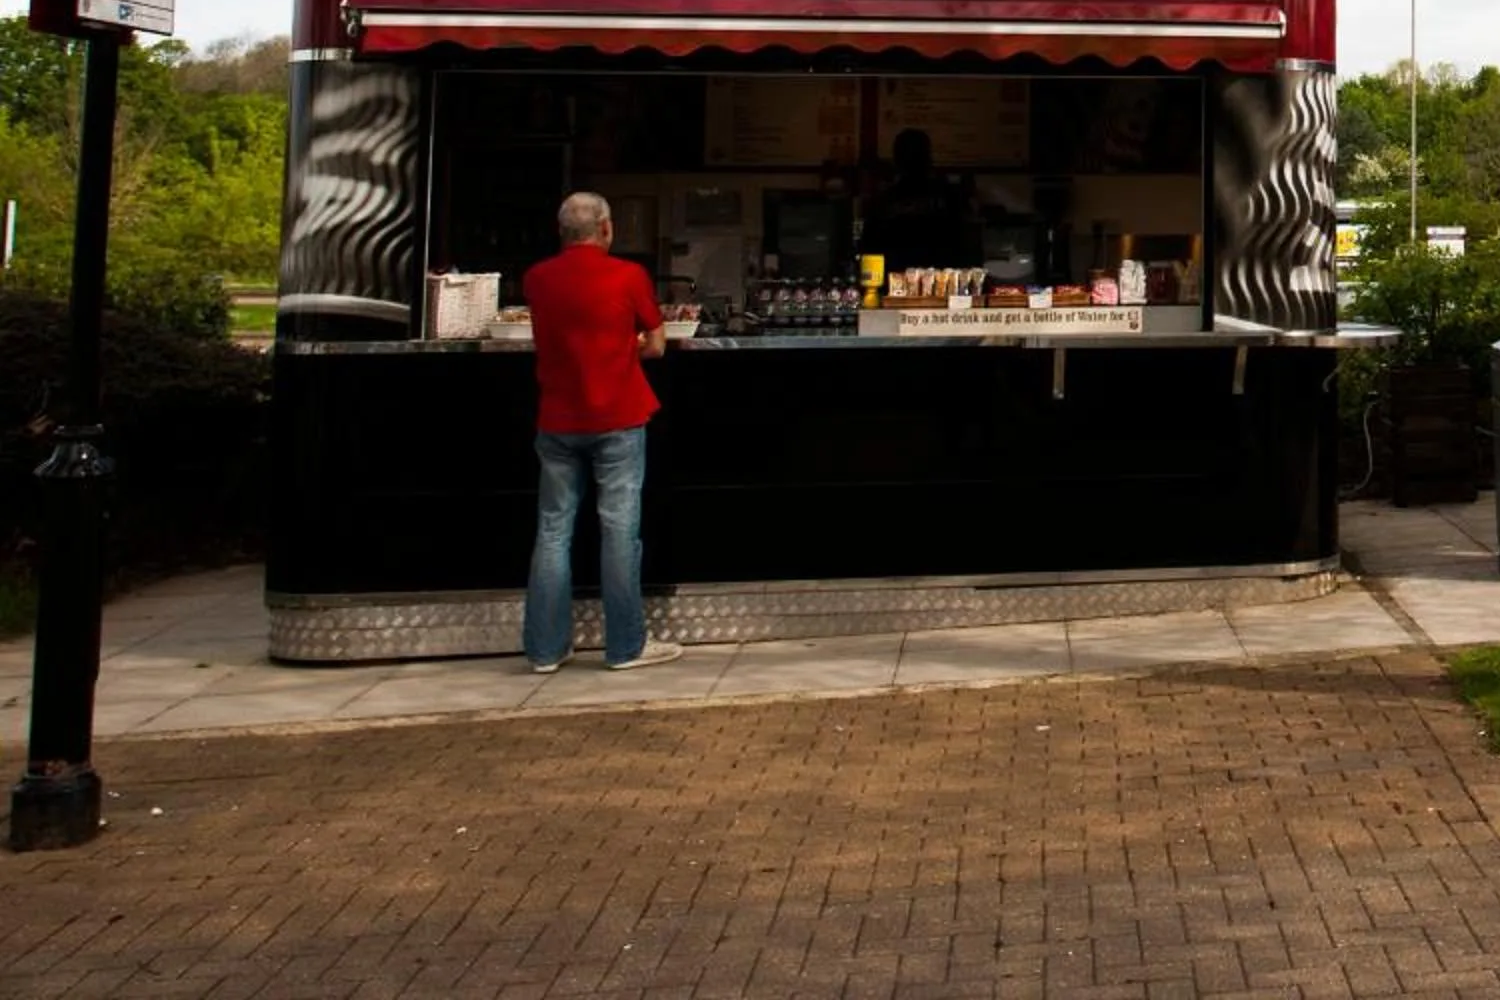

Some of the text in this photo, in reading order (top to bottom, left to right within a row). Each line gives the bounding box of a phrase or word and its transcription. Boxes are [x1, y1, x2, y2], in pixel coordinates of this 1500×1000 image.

[922, 315, 929, 325] a
[932, 313, 949, 324] hot
[951, 312, 978, 324] drink
[982, 312, 1002, 324] and
[1005, 312, 1021, 325] get
[1024, 314, 1031, 323] a
[1033, 311, 1063, 323] bottle
[1066, 311, 1076, 323] of
